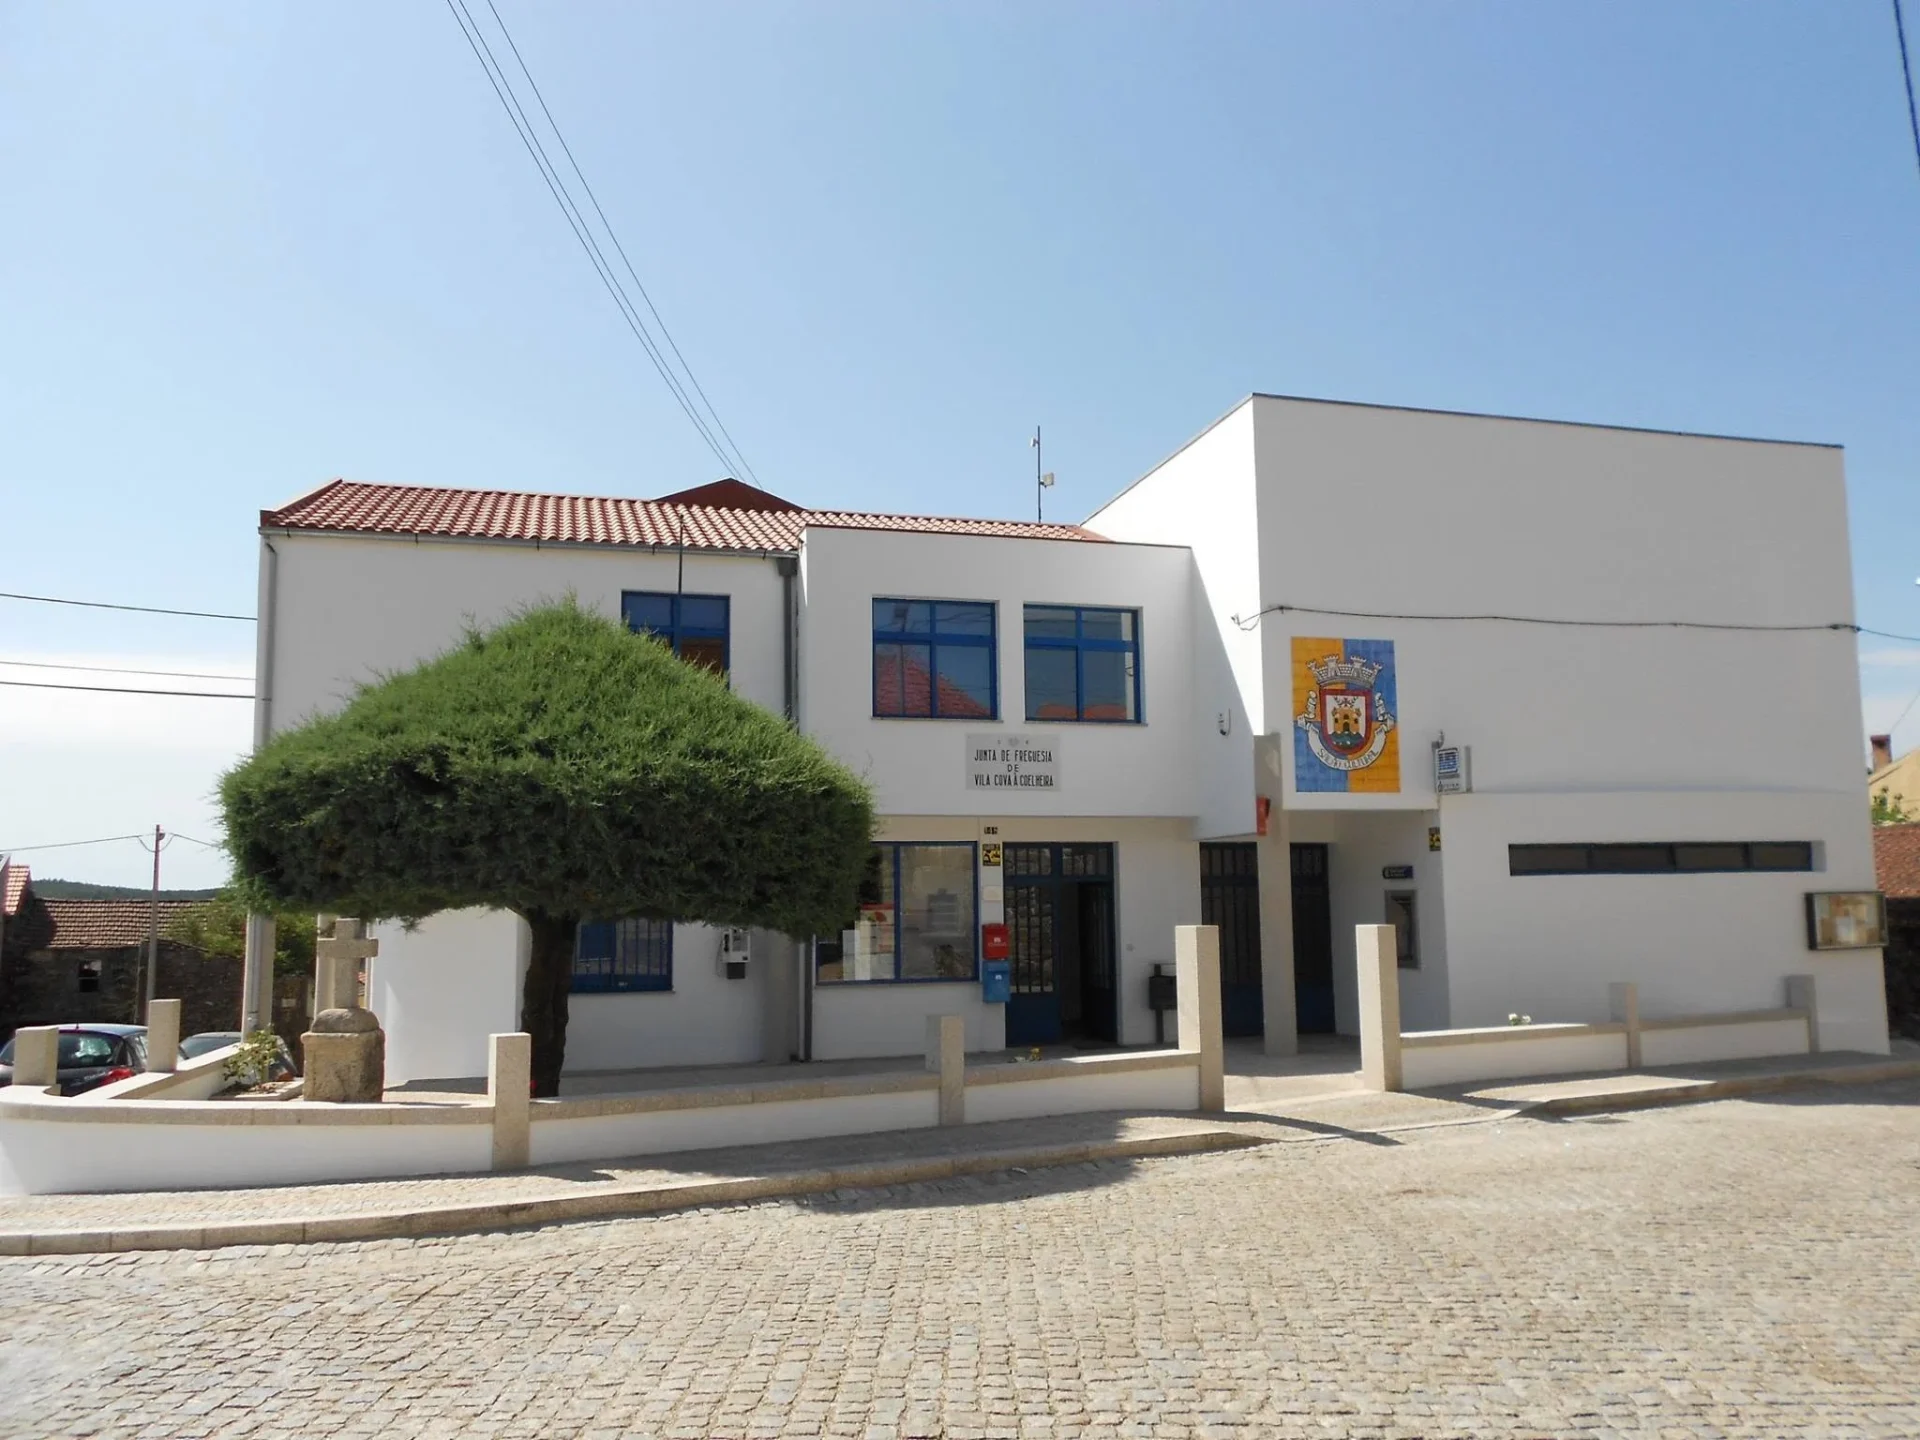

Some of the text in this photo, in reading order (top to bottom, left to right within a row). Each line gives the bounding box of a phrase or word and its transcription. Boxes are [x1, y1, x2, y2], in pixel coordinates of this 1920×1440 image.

[974, 749, 1052, 762] JUNTA DE FREGUESIA
[1007, 764, 1020, 773] DE
[974, 774, 991, 787] VILA
[994, 774, 1012, 787] COVA
[1019, 774, 1054, 787] COELHEIRA
